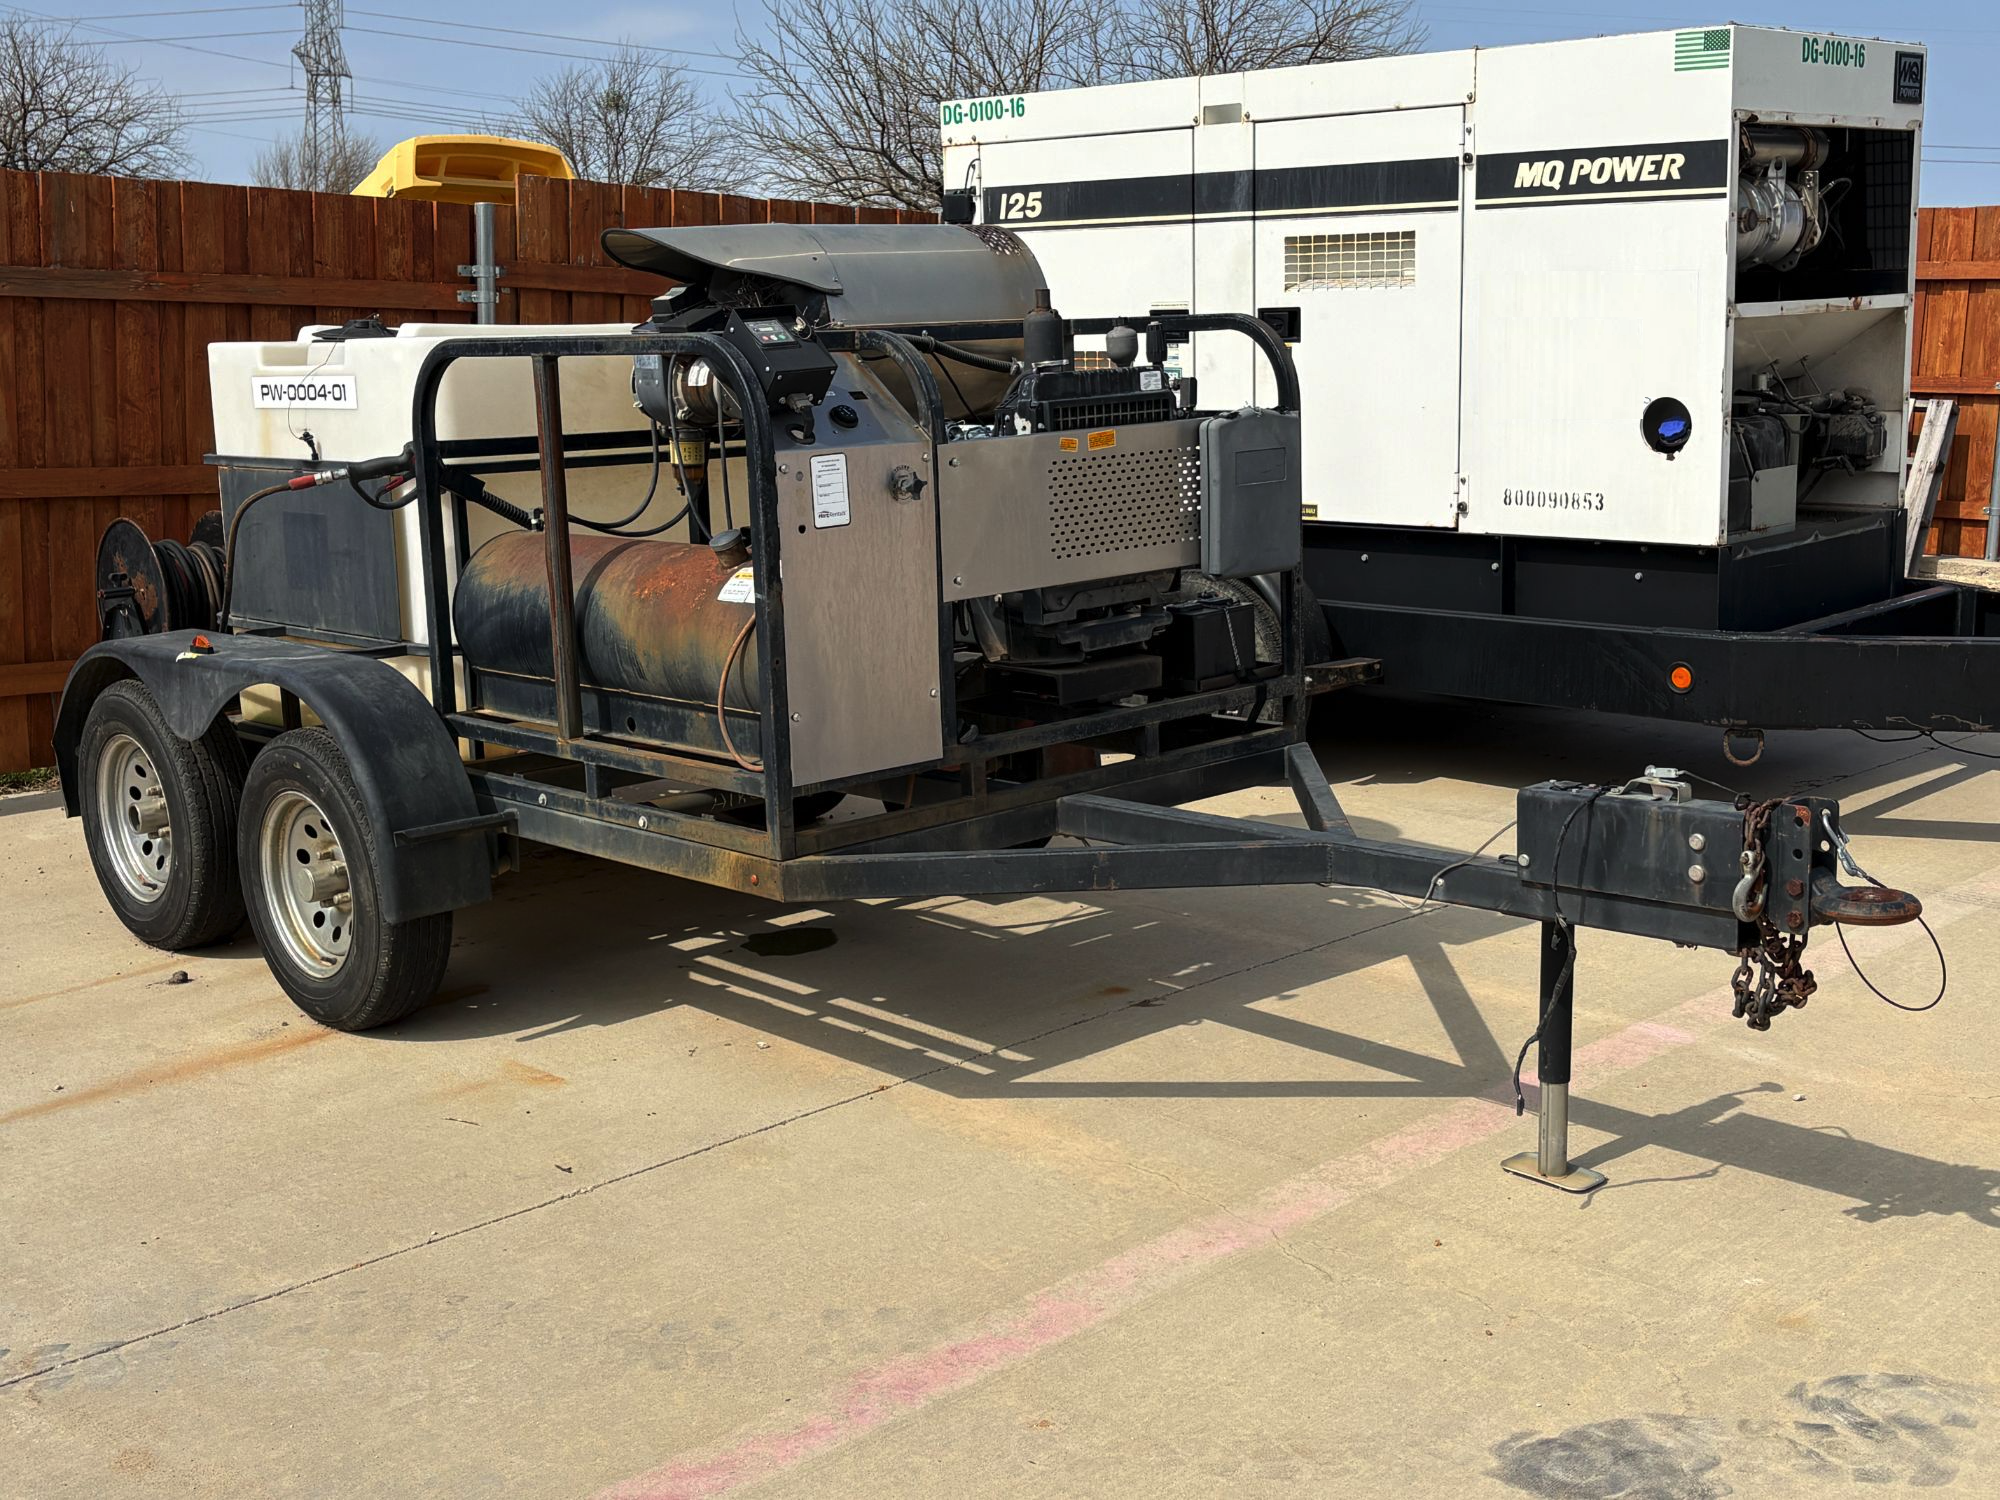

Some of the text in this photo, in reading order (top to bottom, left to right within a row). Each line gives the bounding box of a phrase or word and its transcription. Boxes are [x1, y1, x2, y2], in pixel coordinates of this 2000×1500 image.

[1802, 36, 1866, 69] DG-0100-16
[1900, 60, 1920, 84] MQ
[943, 97, 1025, 126] DG-0100-16
[1514, 153, 1686, 191] MQ POWER
[999, 190, 1043, 220] 125
[260, 383, 347, 402] PW-0004-01
[1503, 487, 1604, 511] 800090853
